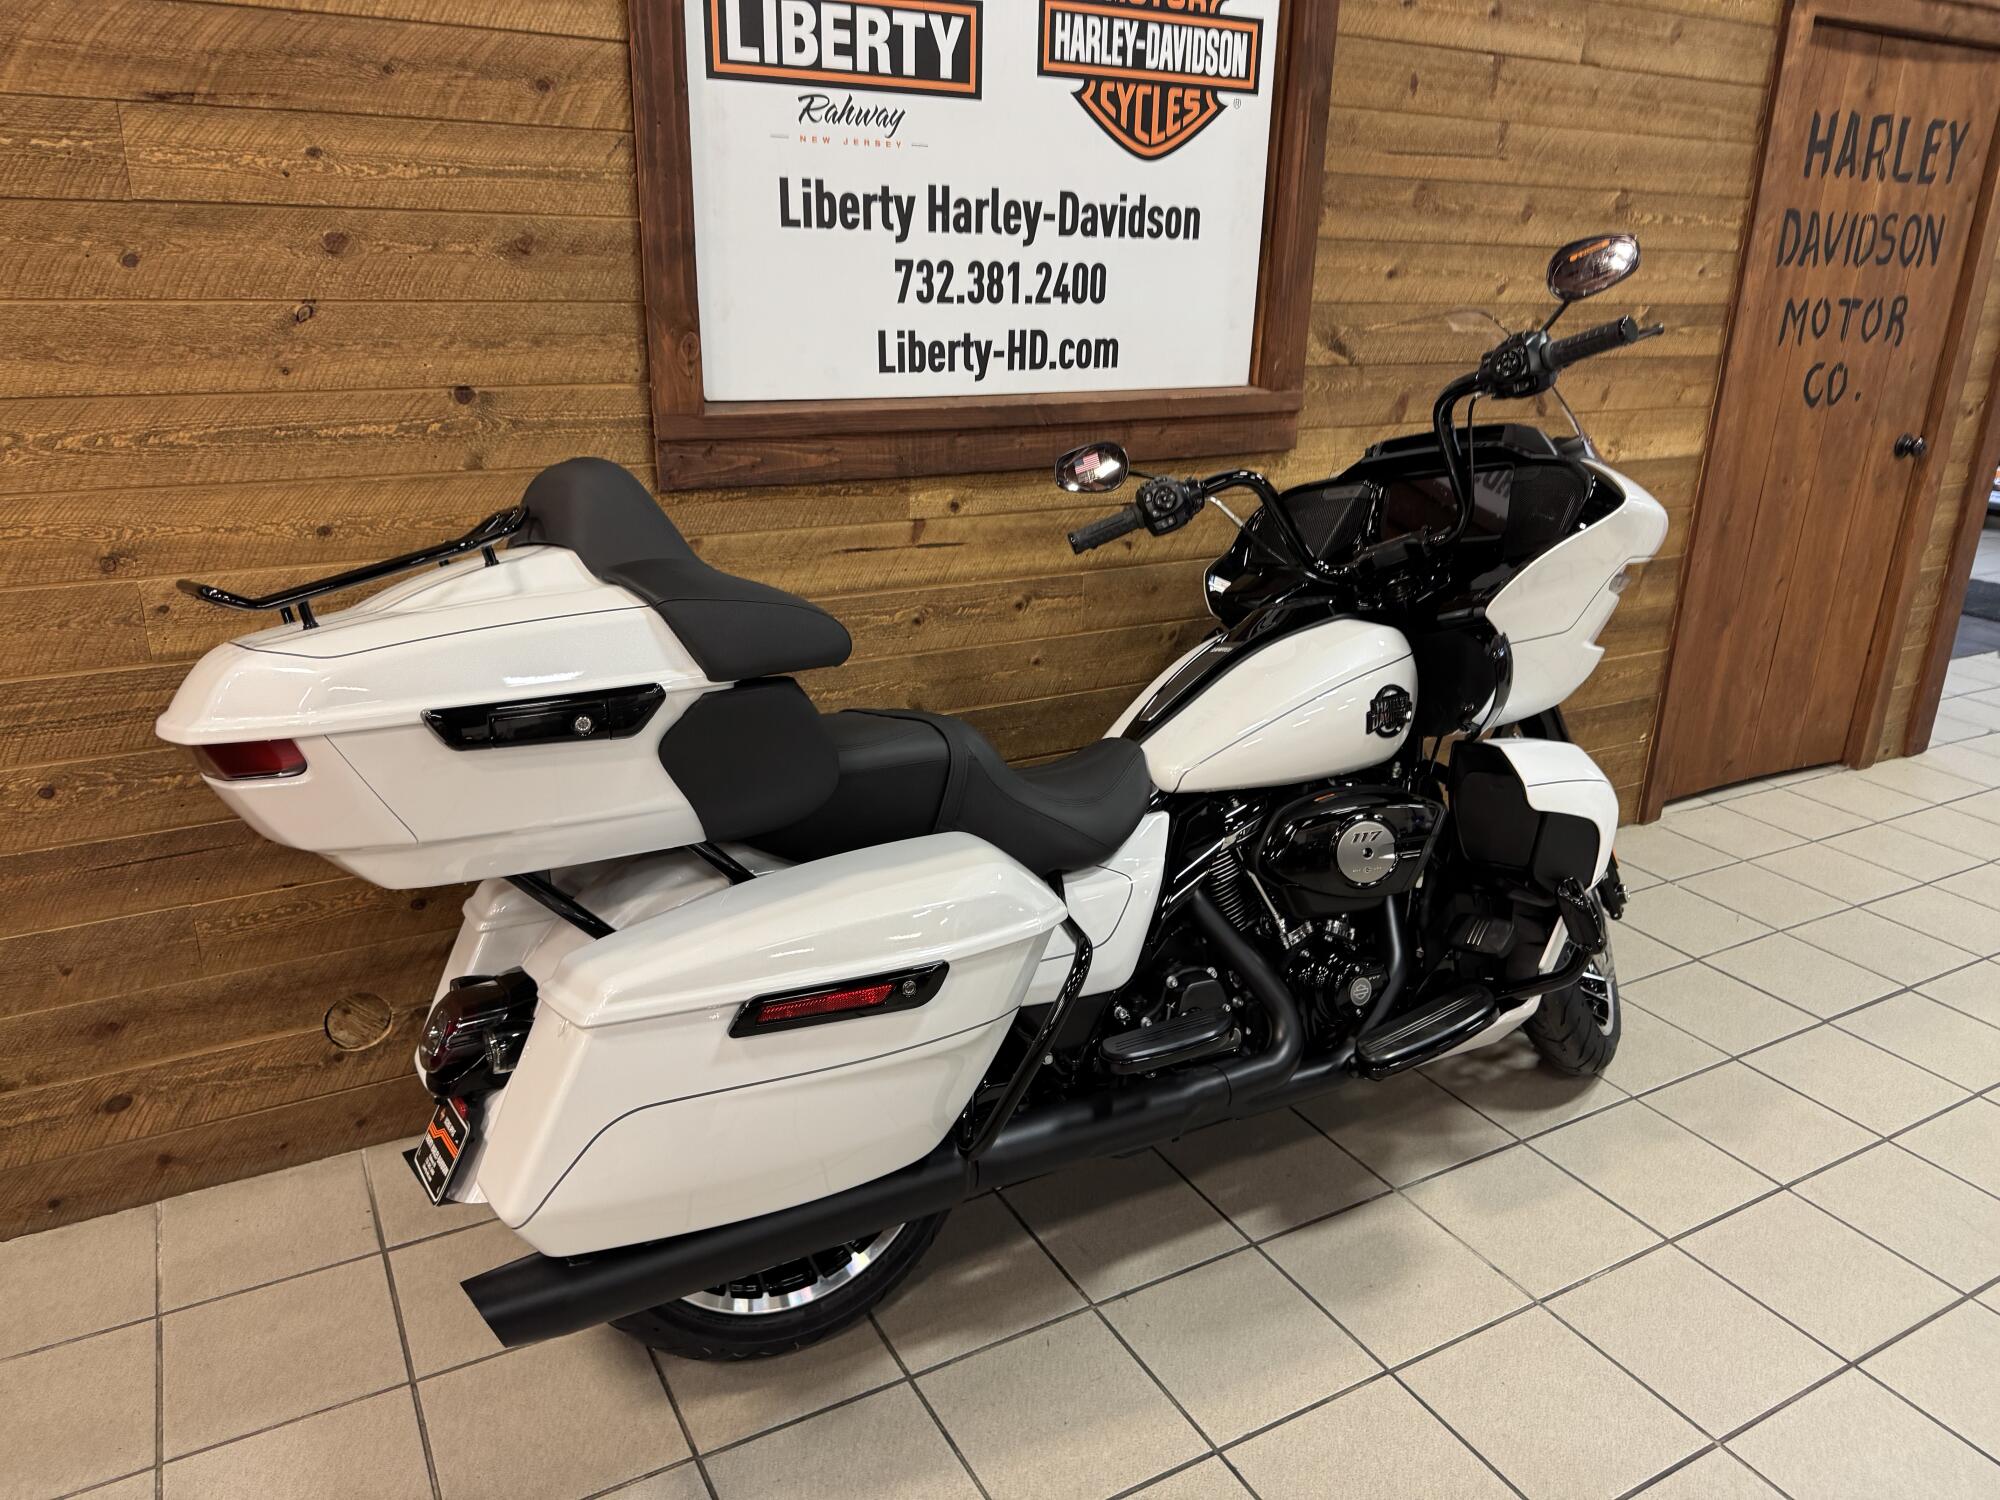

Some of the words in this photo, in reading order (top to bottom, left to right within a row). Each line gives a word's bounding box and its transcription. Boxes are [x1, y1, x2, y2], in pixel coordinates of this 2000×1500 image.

[726, 0, 965, 80] LIBERTY
[1054, 11, 1248, 78] HARLEY-DAVIDSON
[797, 93, 906, 139] Rahway
[1100, 80, 1200, 146] CYCLES
[800, 134, 831, 145] NEW
[843, 137, 902, 149] JERSEY
[1803, 108, 1971, 186] HARLEY
[779, 176, 916, 244] Liberty
[927, 184, 1201, 248] Harley-Davidson
[1776, 207, 1945, 269] DAVIDSON
[894, 258, 1107, 305] 732.381.2400
[1778, 295, 1909, 348] MOTOR
[877, 329, 1119, 383] Liberty-HD.com
[1803, 362, 1862, 408] CO.
[1351, 830, 1383, 844] 117
